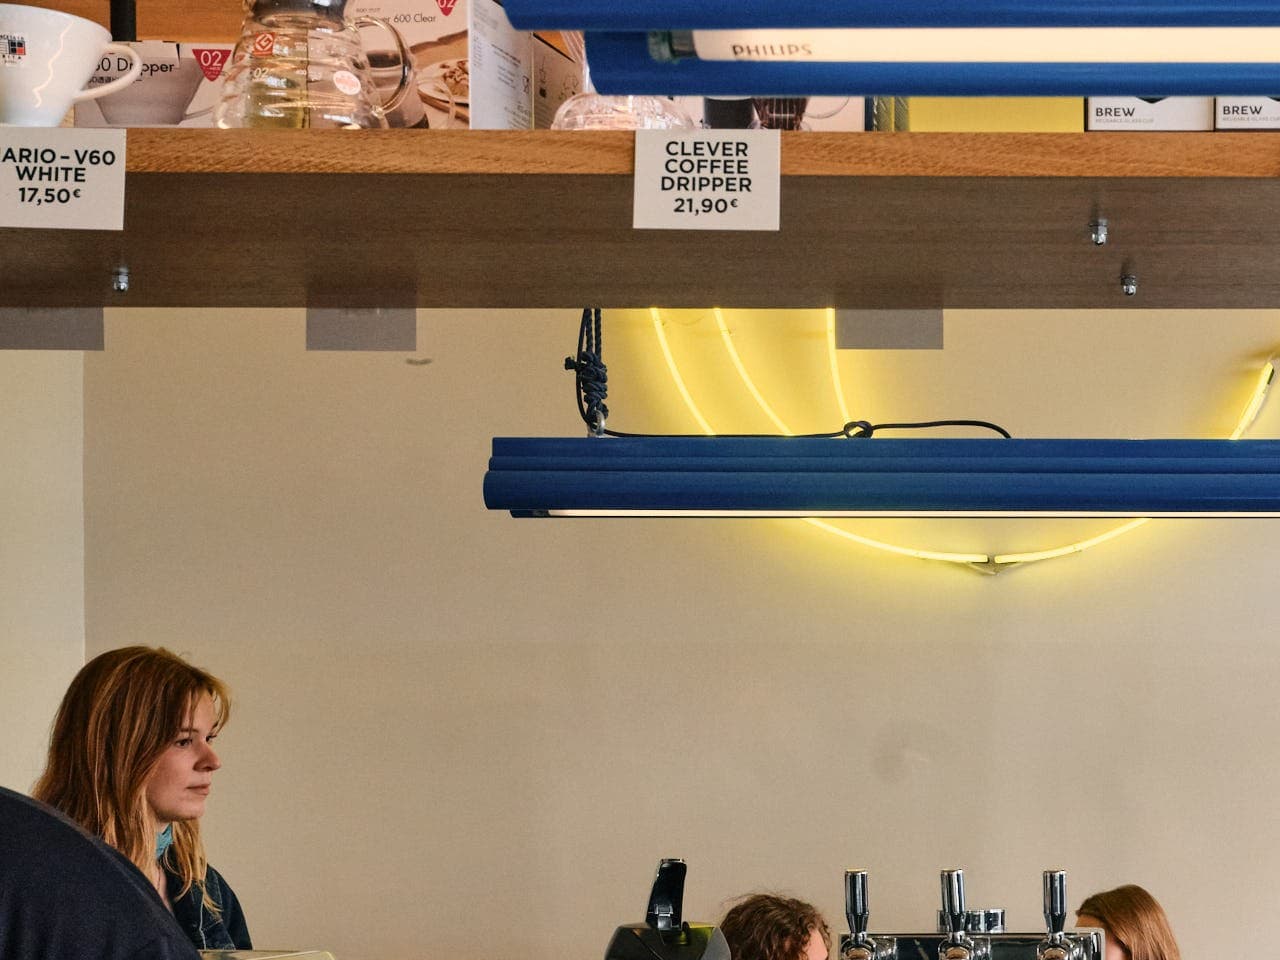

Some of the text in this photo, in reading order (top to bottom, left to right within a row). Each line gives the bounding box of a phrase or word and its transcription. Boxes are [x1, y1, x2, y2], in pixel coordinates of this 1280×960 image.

[413, 13, 436, 23] Clear
[732, 44, 813, 56] PHILIPS
[201, 51, 222, 66] 02
[1095, 107, 1135, 117] BREW
[1223, 105, 1263, 115] BREW
[0, 147, 56, 164] ARIO
[665, 141, 748, 157] CLEVER
[16, 165, 86, 182] WHITE
[664, 158, 749, 174] COFFEE
[660, 176, 752, 192] DRIPPER
[19, 187, 81, 206] 17,50€
[673, 198, 739, 216] 21,90€
